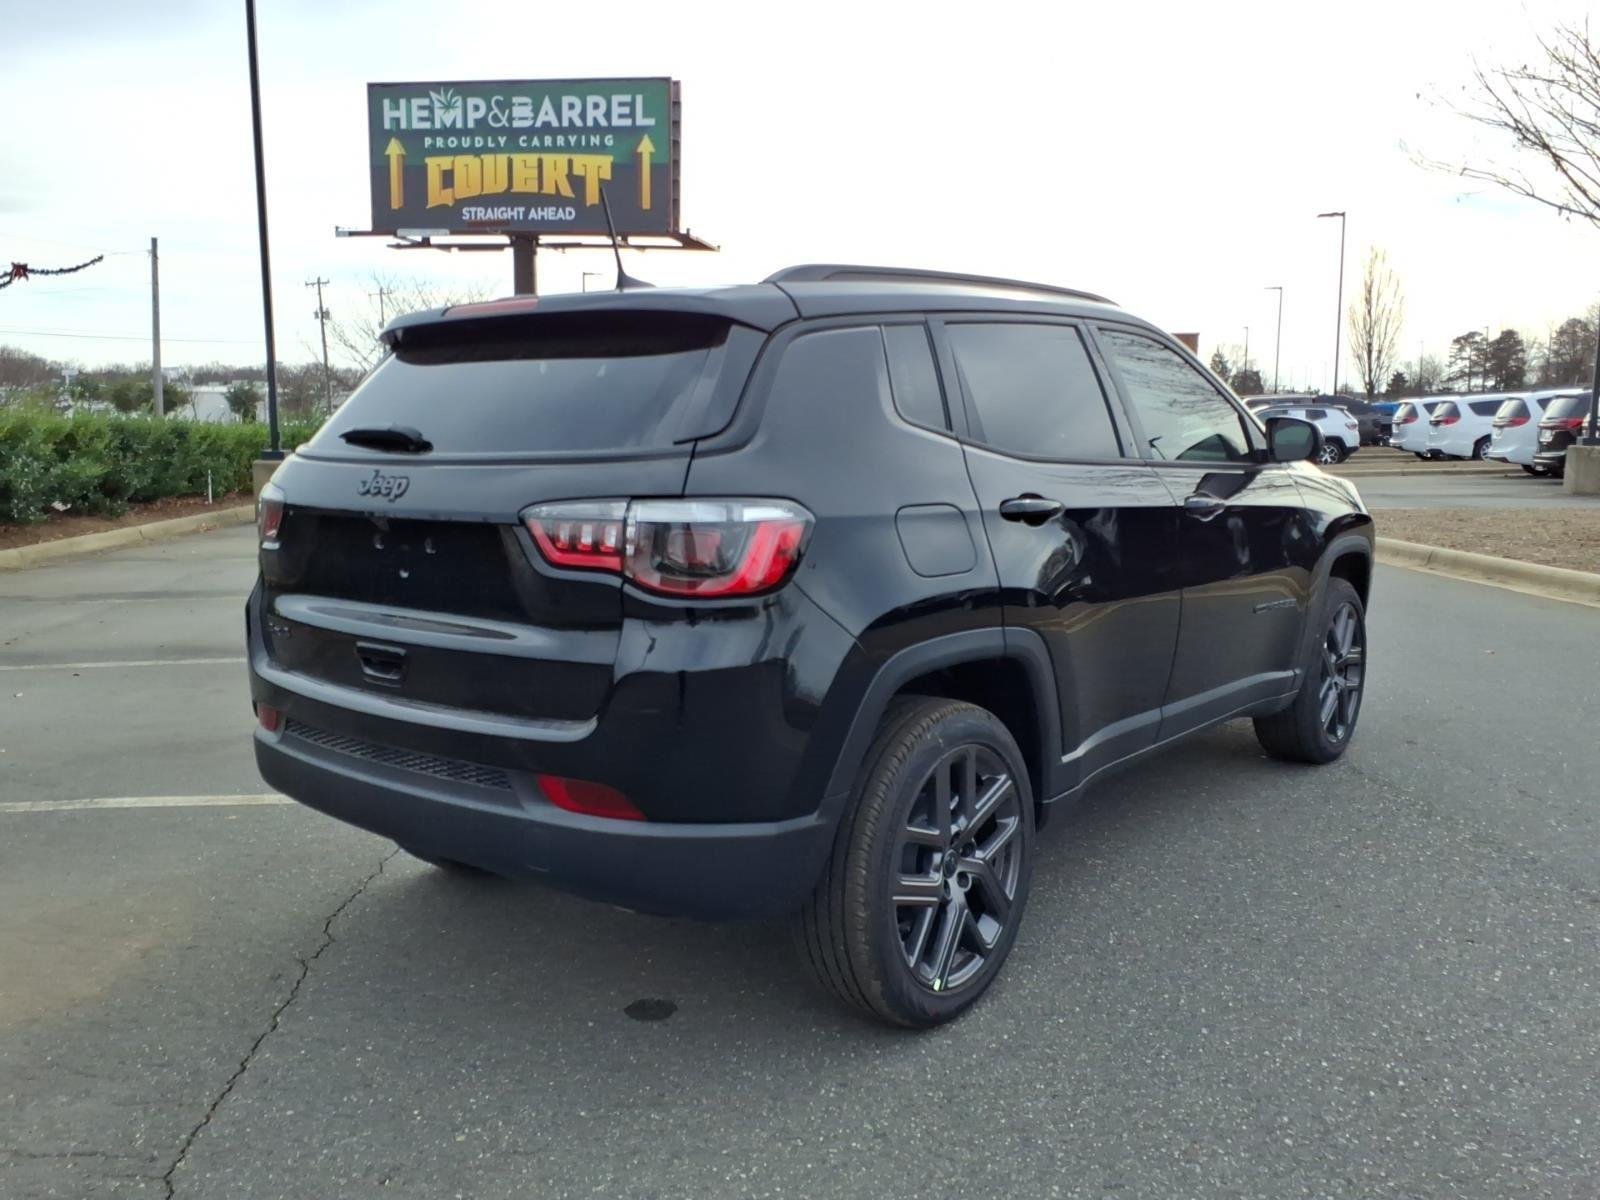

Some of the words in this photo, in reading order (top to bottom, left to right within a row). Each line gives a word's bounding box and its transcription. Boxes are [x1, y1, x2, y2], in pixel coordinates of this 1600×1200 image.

[424, 136, 507, 149] PROUDLY
[519, 134, 614, 147] CARRYING
[461, 206, 525, 221] STRAIGHT
[527, 206, 576, 221] AHEAD
[357, 469, 410, 503] Jeep
